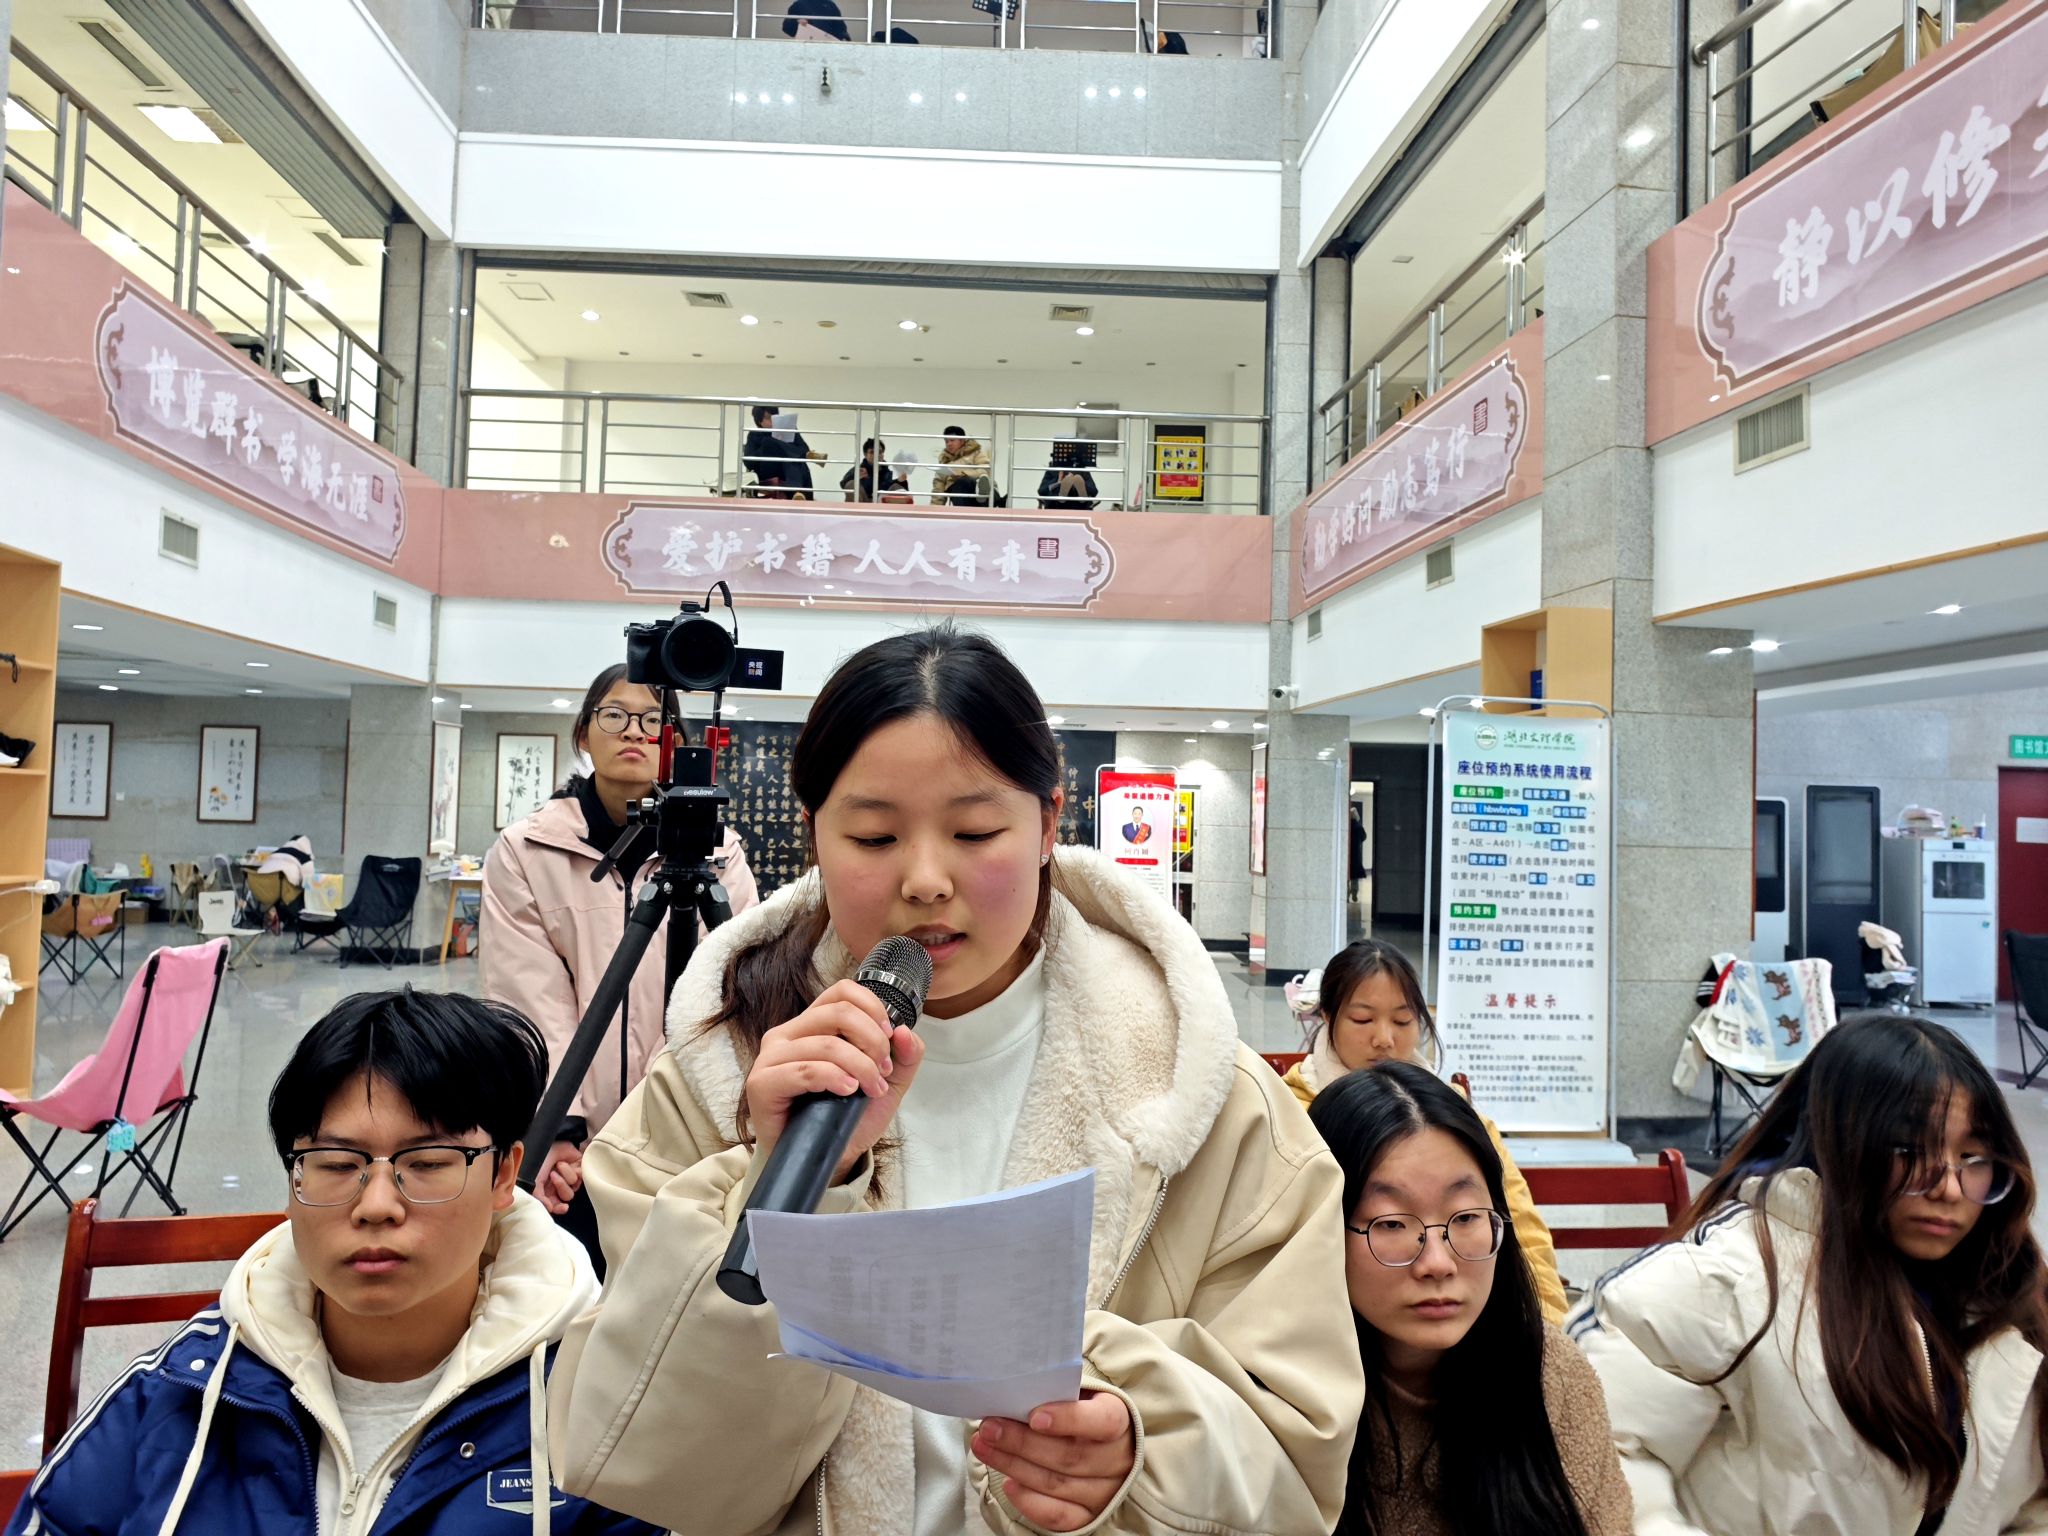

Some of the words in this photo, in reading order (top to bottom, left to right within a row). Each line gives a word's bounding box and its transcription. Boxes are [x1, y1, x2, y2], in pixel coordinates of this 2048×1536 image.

[1772, 82, 2048, 308] 静以修
[661, 524, 837, 578] 爱护书籍
[853, 538, 1027, 585] 人人有责
[1457, 760, 1592, 780] 座位预约系统使用流程
[1454, 905, 1492, 915] 预约签到
[1485, 993, 1557, 1009] 温馨提示
